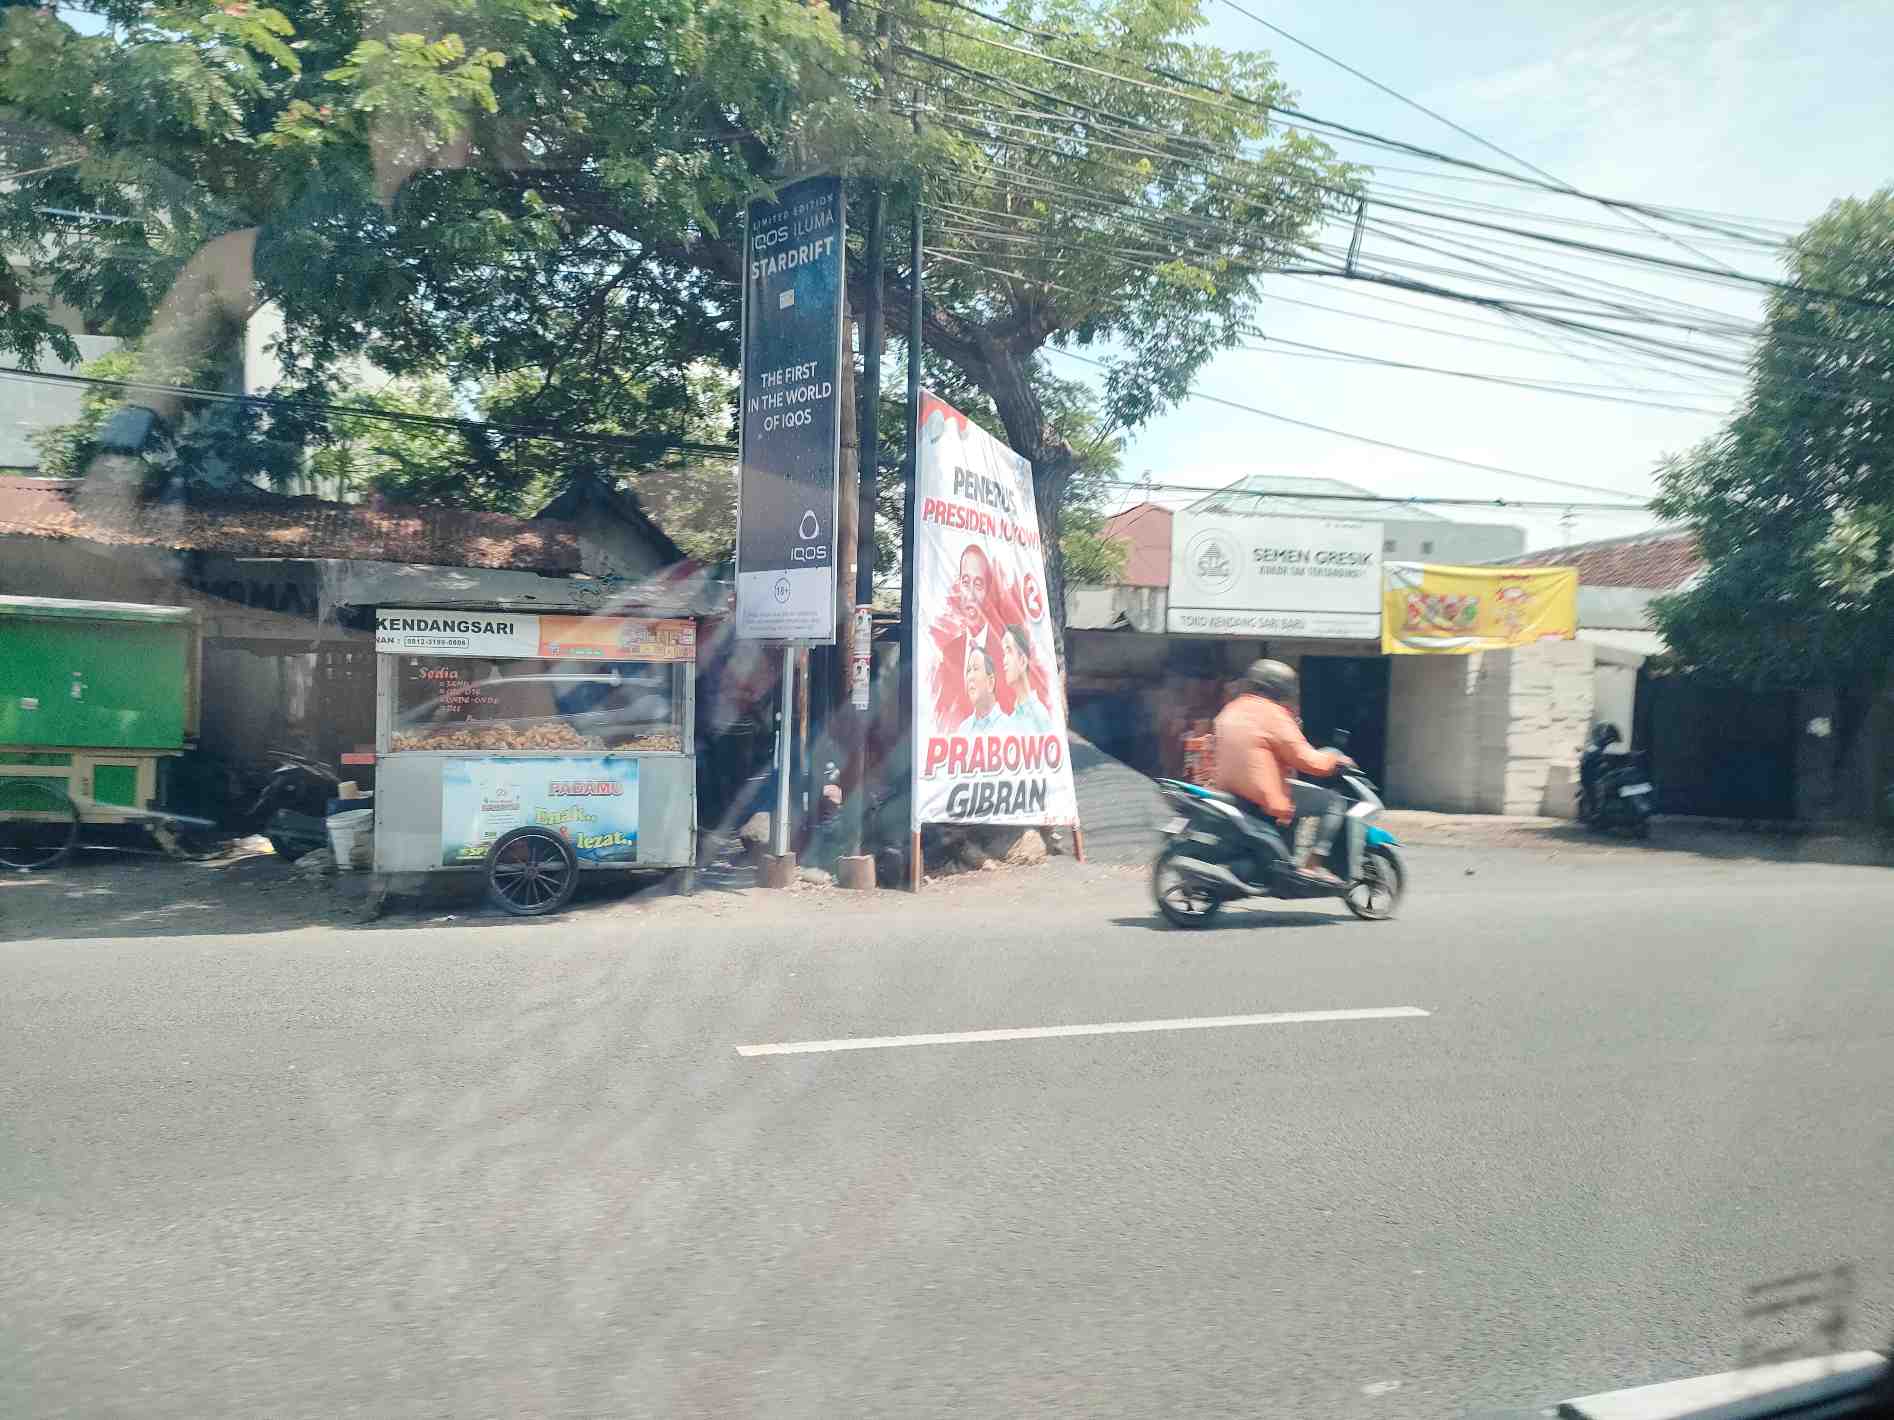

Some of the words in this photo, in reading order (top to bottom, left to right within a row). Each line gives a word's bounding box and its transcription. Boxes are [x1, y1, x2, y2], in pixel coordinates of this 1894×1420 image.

[751, 226, 789, 252] IQOS
[793, 209, 835, 238] ILUMA
[753, 210, 789, 232] LIMITED
[792, 193, 834, 216] EDITION
[751, 236, 834, 280] STARDRIFT
[761, 370, 785, 389] THE
[786, 361, 818, 382] FIRST
[748, 397, 759, 413] IN
[760, 391, 784, 410] THE
[785, 382, 832, 406] WORLD
[763, 415, 780, 432] OF
[782, 408, 812, 429] IQOS
[953, 465, 1018, 514] PENERUS
[922, 496, 996, 539] PRESIDEN
[790, 545, 827, 562] IQOS
[1252, 547, 1311, 564] SEMEN
[376, 617, 514, 635] KENDANGSARI
[924, 734, 1064, 777] PRABOWO
[945, 777, 1048, 819] GIBRAN
